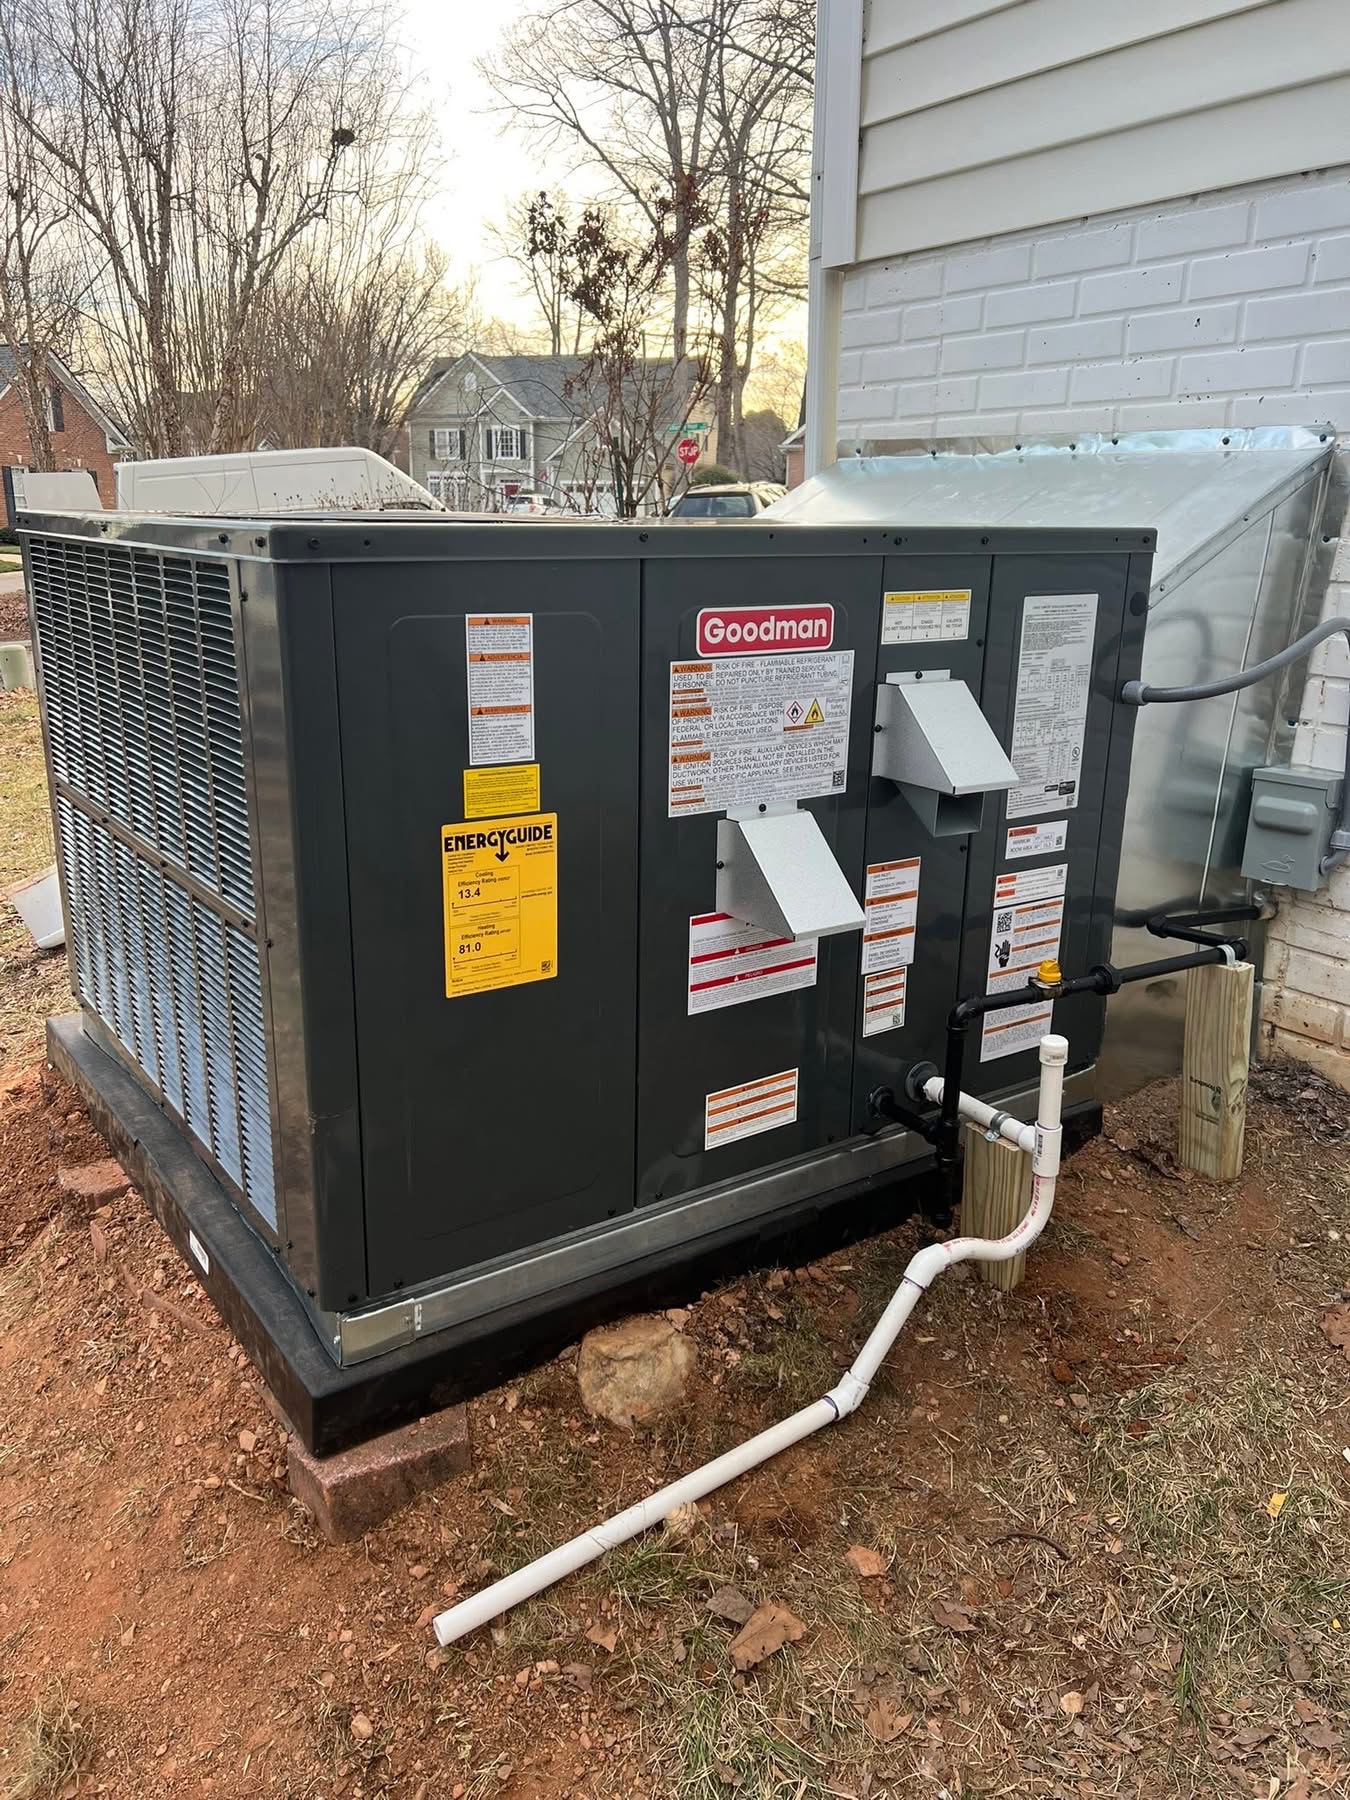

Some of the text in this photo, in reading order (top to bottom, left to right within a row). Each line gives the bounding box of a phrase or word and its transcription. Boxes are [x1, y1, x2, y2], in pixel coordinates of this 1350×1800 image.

[679, 446, 698, 457] STOP
[704, 615, 827, 644] Goodman
[680, 663, 712, 672] WARNING
[760, 659, 795, 668] FLAMMABLE
[796, 656, 836, 664] REFRIGERANT
[716, 671, 747, 679] REPAIRED
[741, 675, 774, 684] PUNCTURE
[775, 672, 816, 681] REFRIGERANT
[680, 707, 711, 717] WARNING
[758, 702, 784, 710] DISPOSE
[683, 716, 716, 724] PROPERLY
[726, 711, 767, 720] ACCORDANCE
[672, 732, 711, 741] FLAMMABLE
[712, 728, 754, 737] REFRIGERANT
[679, 752, 710, 762] WARNING
[757, 745, 787, 753] AUXILIARY
[788, 742, 812, 750] DEVICES
[683, 761, 711, 770] IGNITION
[712, 758, 742, 767] SOURCES
[743, 755, 761, 763] SHALL
[785, 748, 815, 758] INSTALLED
[712, 766, 734, 774] OTHER
[752, 760, 783, 769] AUXILIARY
[783, 757, 808, 765] DEVICES
[809, 754, 828, 762] LISTED
[719, 772, 746, 781] SPECIFIC
[444, 824, 552, 852] ENERGYGUIDE
[458, 879, 481, 887] Efficiency
[458, 887, 481, 899] 13.4
[461, 932, 484, 940] Efficiency
[459, 942, 481, 954] 81.0
